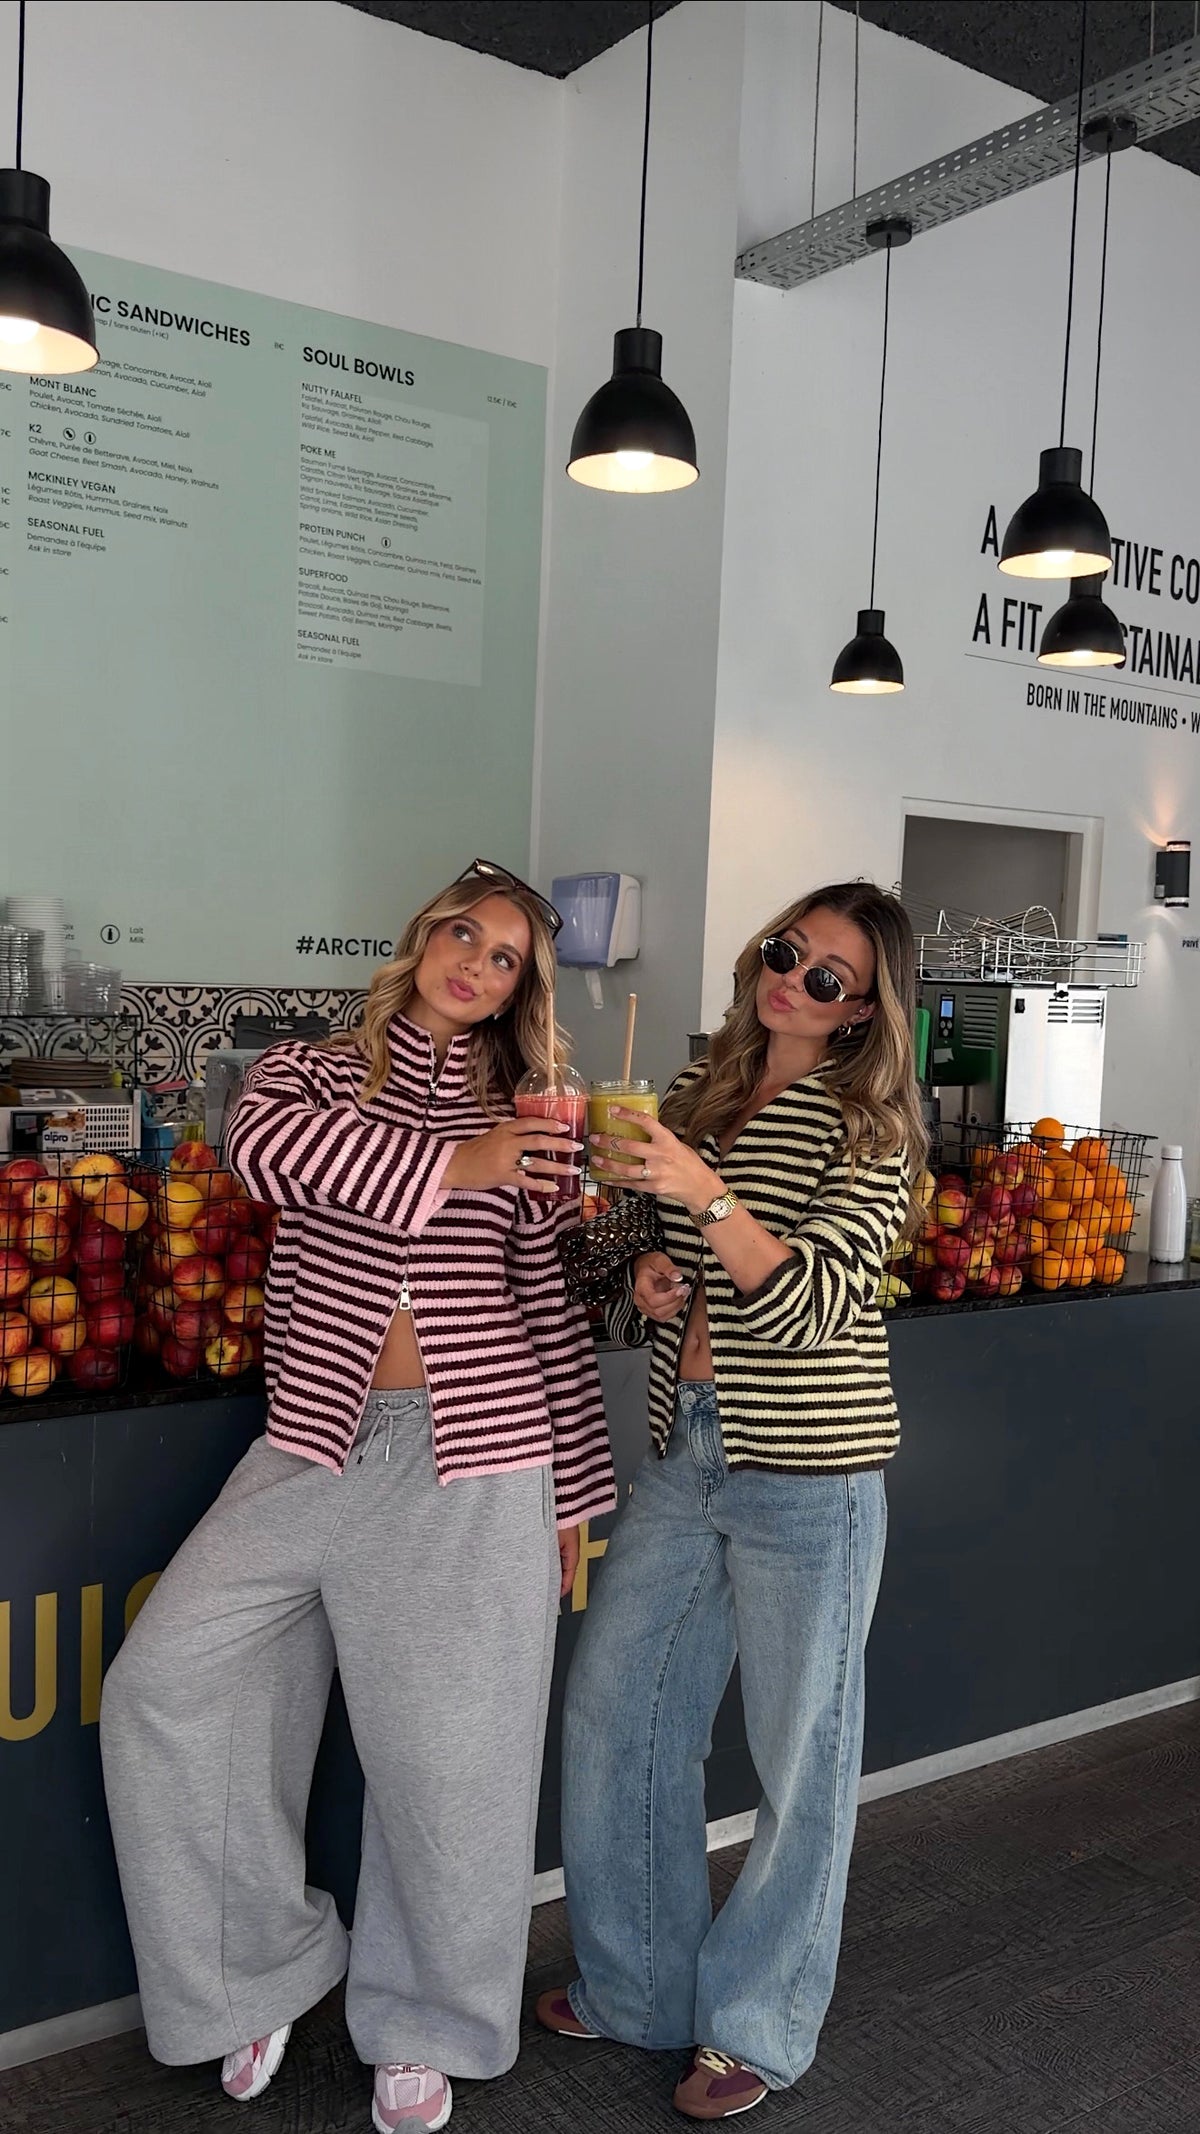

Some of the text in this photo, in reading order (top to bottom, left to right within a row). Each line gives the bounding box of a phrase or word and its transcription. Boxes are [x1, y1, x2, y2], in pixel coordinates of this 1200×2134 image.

[117, 301, 250, 346] SANDWICHES
[130, 324, 151, 335] Gluten
[303, 346, 415, 386] SOUL BOWLS
[30, 376, 96, 397] MONT BLANC
[302, 383, 362, 403] NUTTY FALAFEL
[29, 424, 42, 433] K2
[301, 444, 336, 458] POKE ME
[29, 447, 48, 458] Goat
[82, 457, 99, 467] Beet
[191, 478, 219, 490] Walnuts
[28, 471, 116, 494] MCKINLEY VEGAN
[28, 494, 50, 504] Roast
[123, 510, 142, 520] Seed
[159, 517, 188, 528] Walnuts
[27, 518, 105, 538] SEASONAL FUEL
[300, 523, 365, 542] PROTEIN PUNCH
[27, 533, 68, 546] Demandez
[28, 544, 41, 552] Ask
[52, 548, 72, 556] store
[981, 505, 999, 557] A
[1103, 537, 1163, 596] TIVE
[299, 567, 348, 583] SUPERFOOD
[972, 593, 991, 644] A
[1001, 597, 1042, 653] FIT
[298, 630, 360, 646] SEASONAL FUEL
[1027, 683, 1062, 711] BORN
[1067, 690, 1079, 714] IN
[1084, 693, 1106, 718] THE
[1110, 697, 1178, 729] MOUNTAINS
[44, 1131, 68, 1144] alpro
